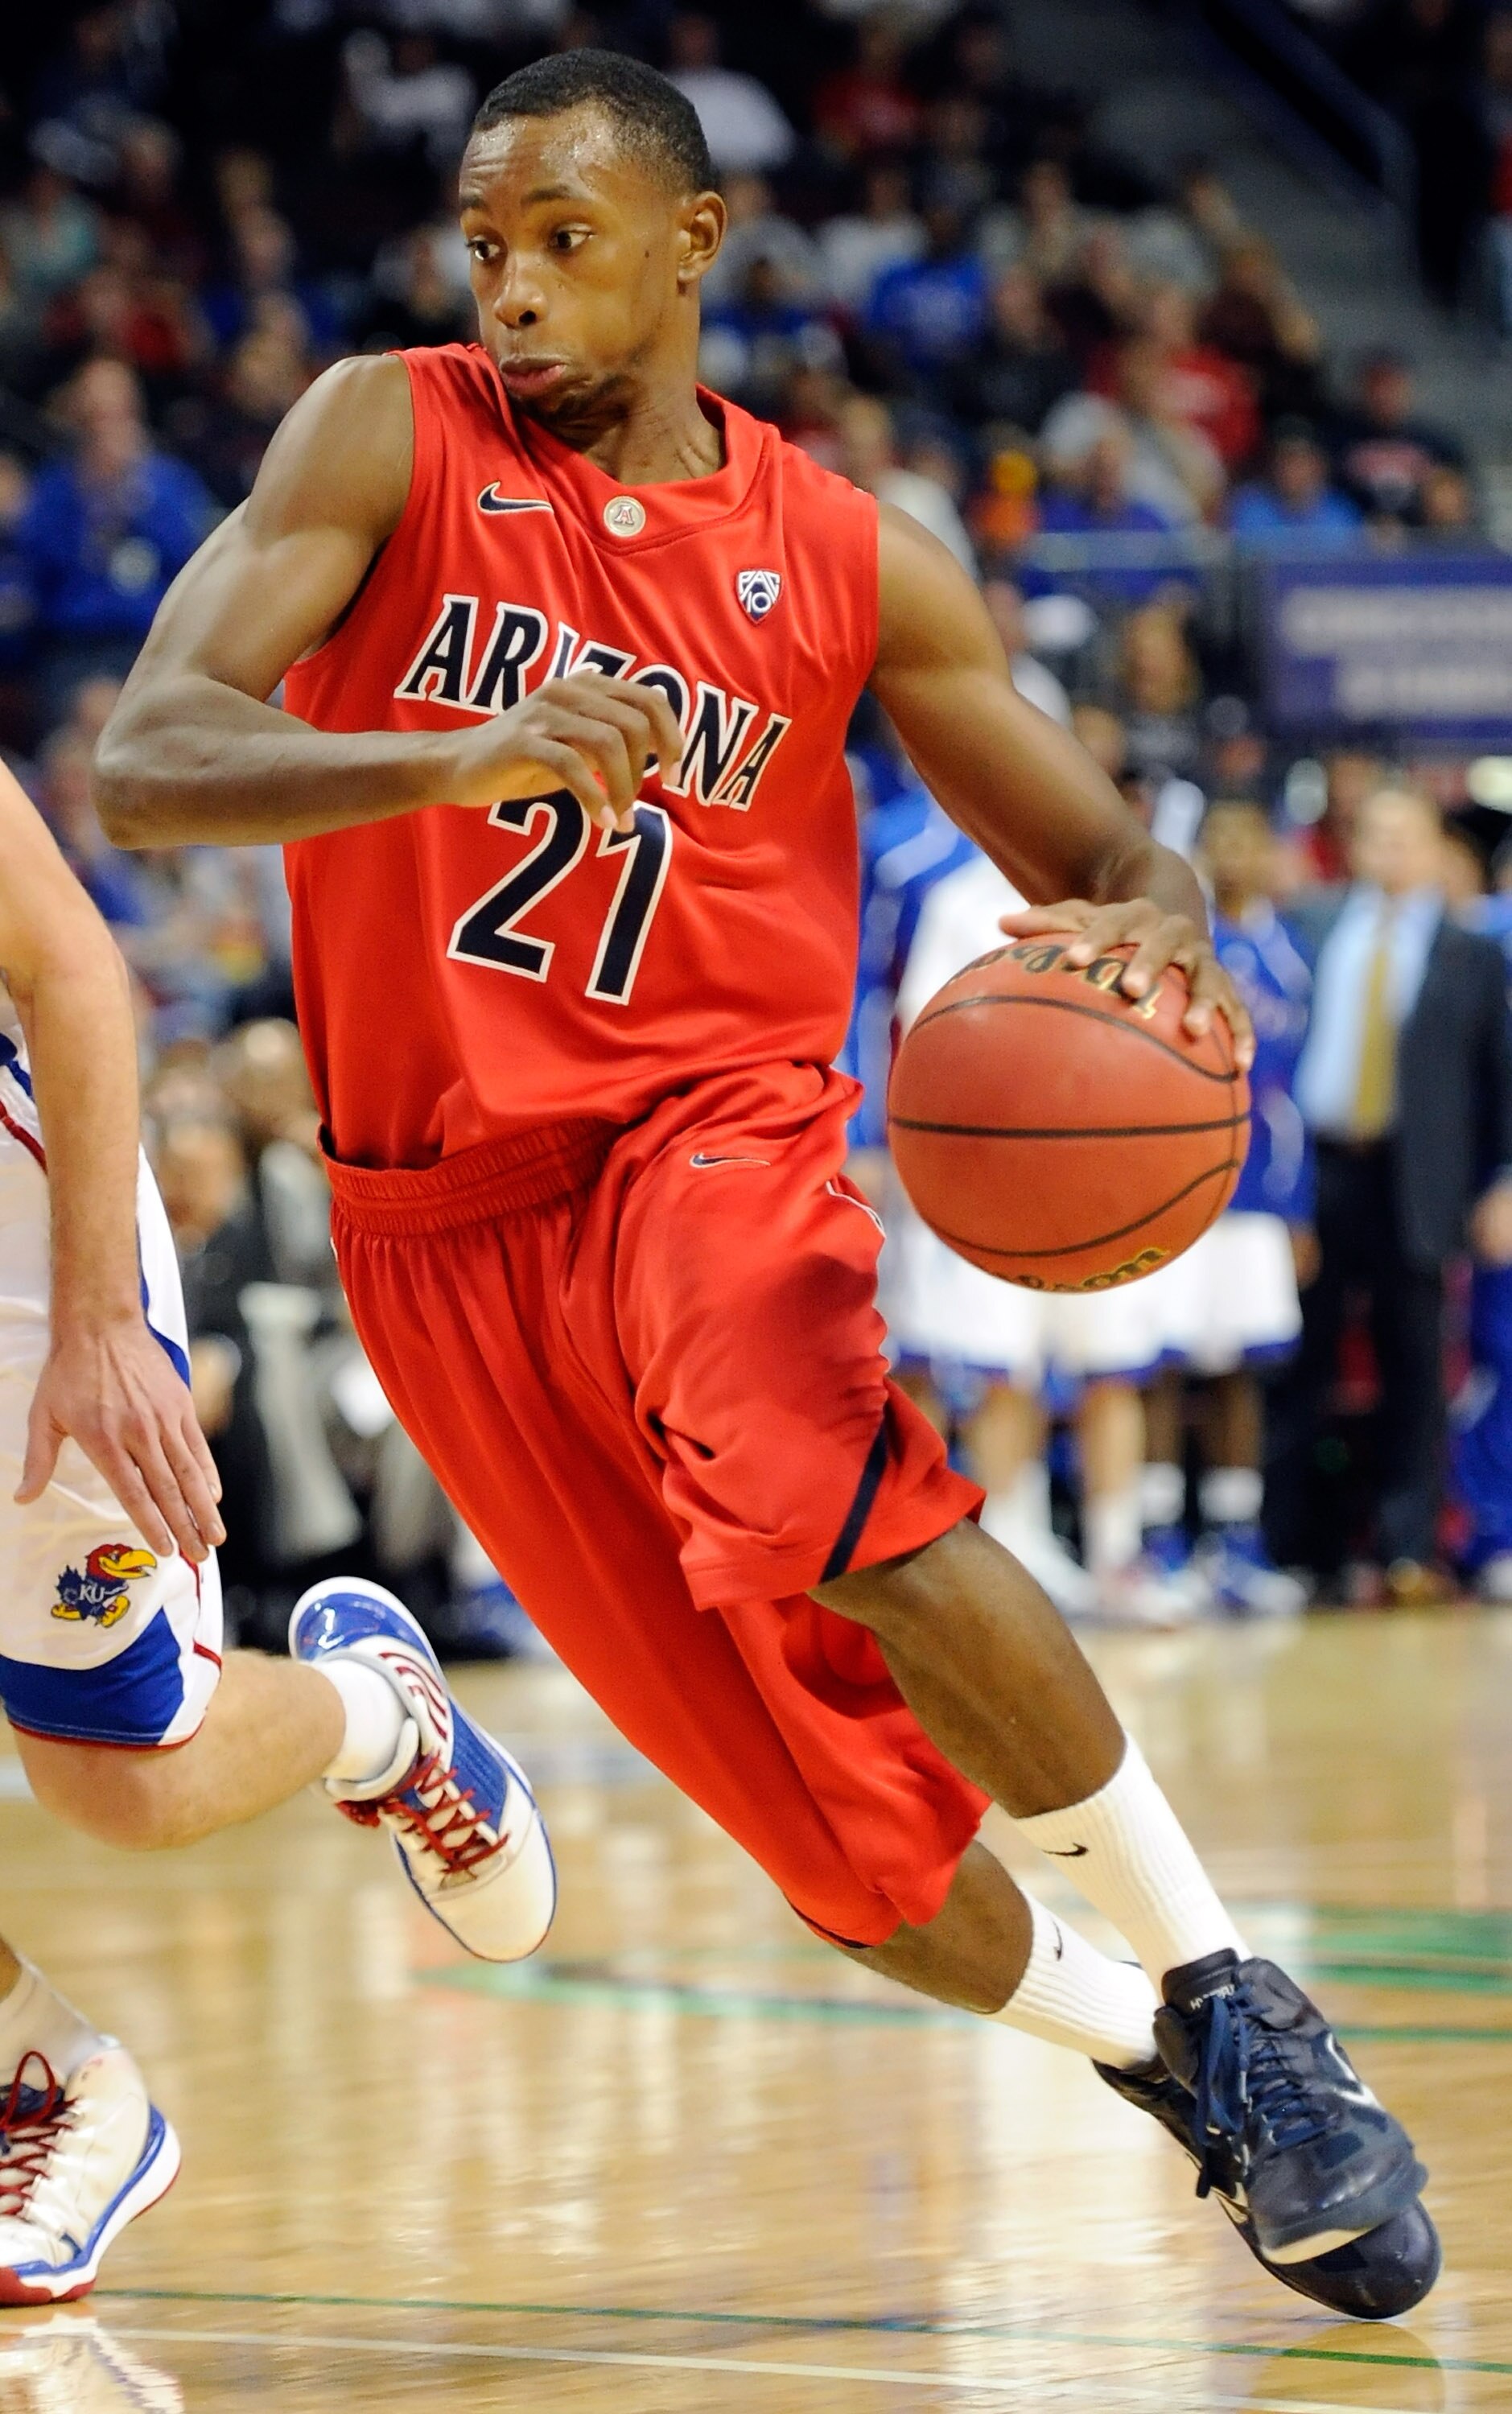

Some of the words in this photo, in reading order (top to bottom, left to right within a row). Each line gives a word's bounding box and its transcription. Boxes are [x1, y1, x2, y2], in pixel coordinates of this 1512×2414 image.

[613, 505, 635, 525] A
[738, 570, 781, 605] PAC
[746, 590, 773, 614] 10
[447, 787, 673, 1006] 21
